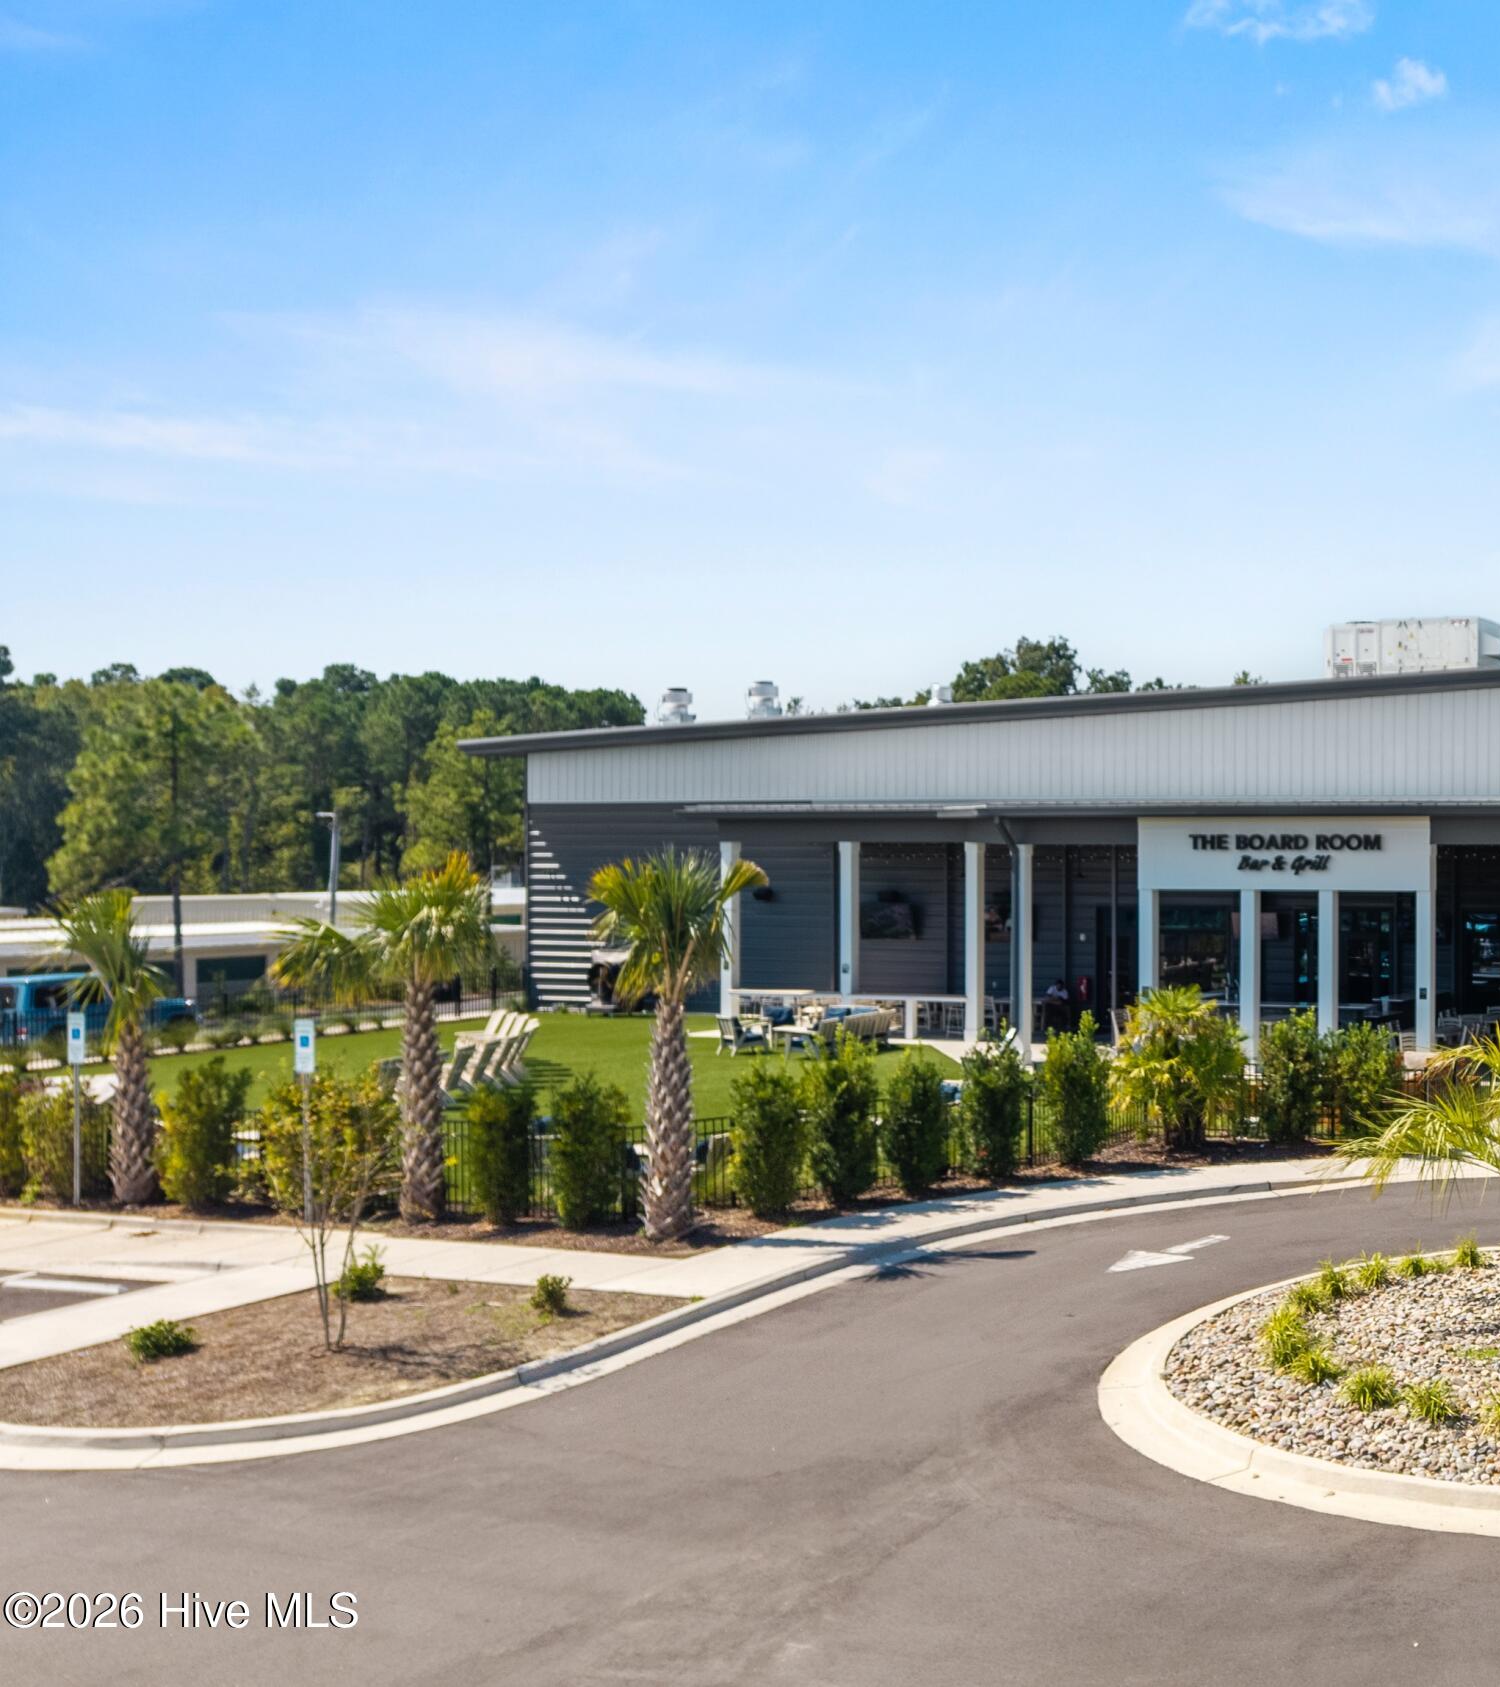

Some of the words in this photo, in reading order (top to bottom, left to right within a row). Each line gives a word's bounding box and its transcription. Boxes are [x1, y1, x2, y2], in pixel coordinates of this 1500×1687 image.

[1188, 834, 1229, 850] THE
[1235, 834, 1309, 850] BOARD
[1316, 834, 1382, 850] ROOM
[1237, 854, 1270, 870] Bar
[1271, 855, 1287, 870] &
[1291, 854, 1331, 875] Grill
